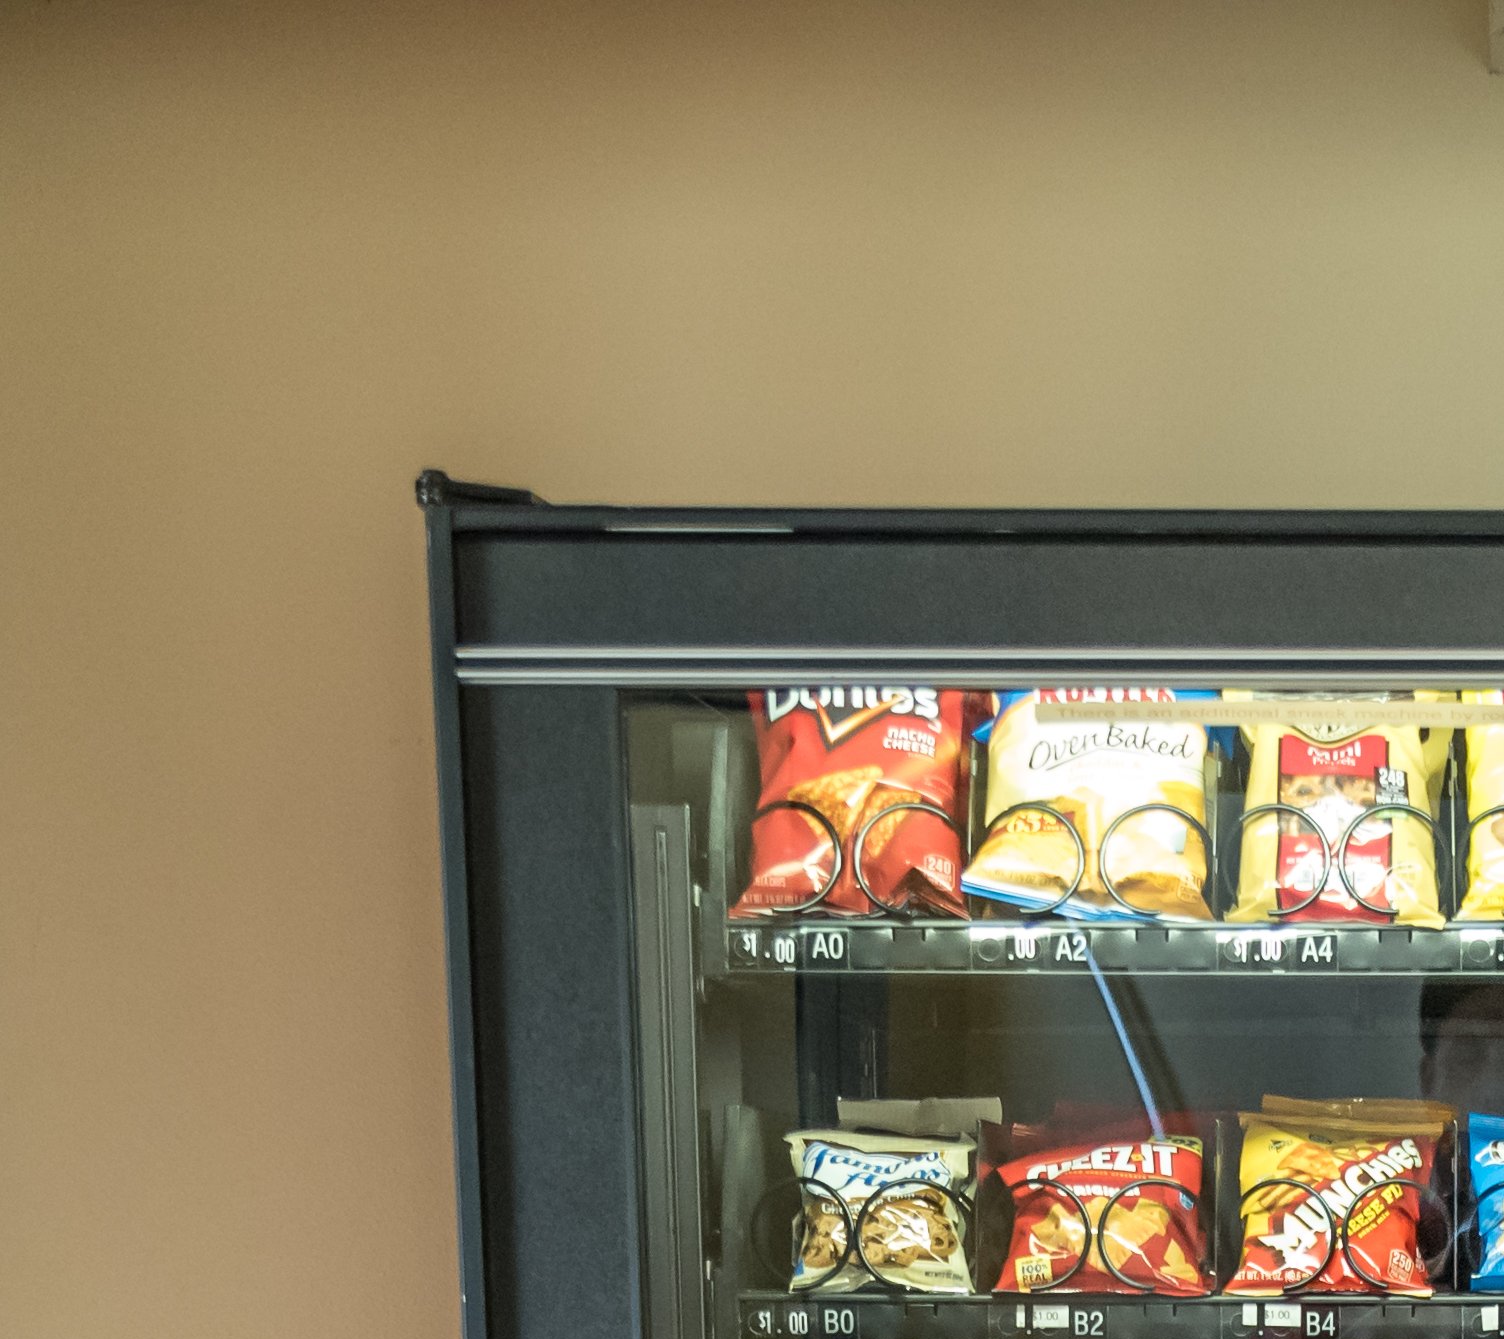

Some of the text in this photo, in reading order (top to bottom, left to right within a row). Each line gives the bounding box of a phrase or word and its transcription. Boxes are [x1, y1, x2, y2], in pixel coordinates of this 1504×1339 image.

[1059, 707, 1116, 719] There
[1123, 707, 1138, 719] is
[1146, 709, 1172, 719] an
[1178, 706, 1279, 719] additional
[1287, 707, 1345, 720] snack
[1354, 708, 1442, 721] machine
[1450, 709, 1472, 723] by
[883, 737, 936, 758] CHEESE
[1028, 724, 1196, 770] Oven Baked
[927, 858, 952, 875] 240
[812, 933, 844, 960] A0
[1055, 935, 1088, 962] A2
[1301, 937, 1334, 962] A4
[1026, 1143, 1179, 1191] CHEEZ-IT
[1021, 1264, 1048, 1276] 100%
[1392, 1251, 1411, 1270] 250
[824, 1310, 854, 1335] B0
[1032, 1311, 1059, 1322] $1.00
[1074, 1311, 1104, 1336] B2
[1263, 1309, 1291, 1321] $1.00
[1306, 1312, 1336, 1337] B4
